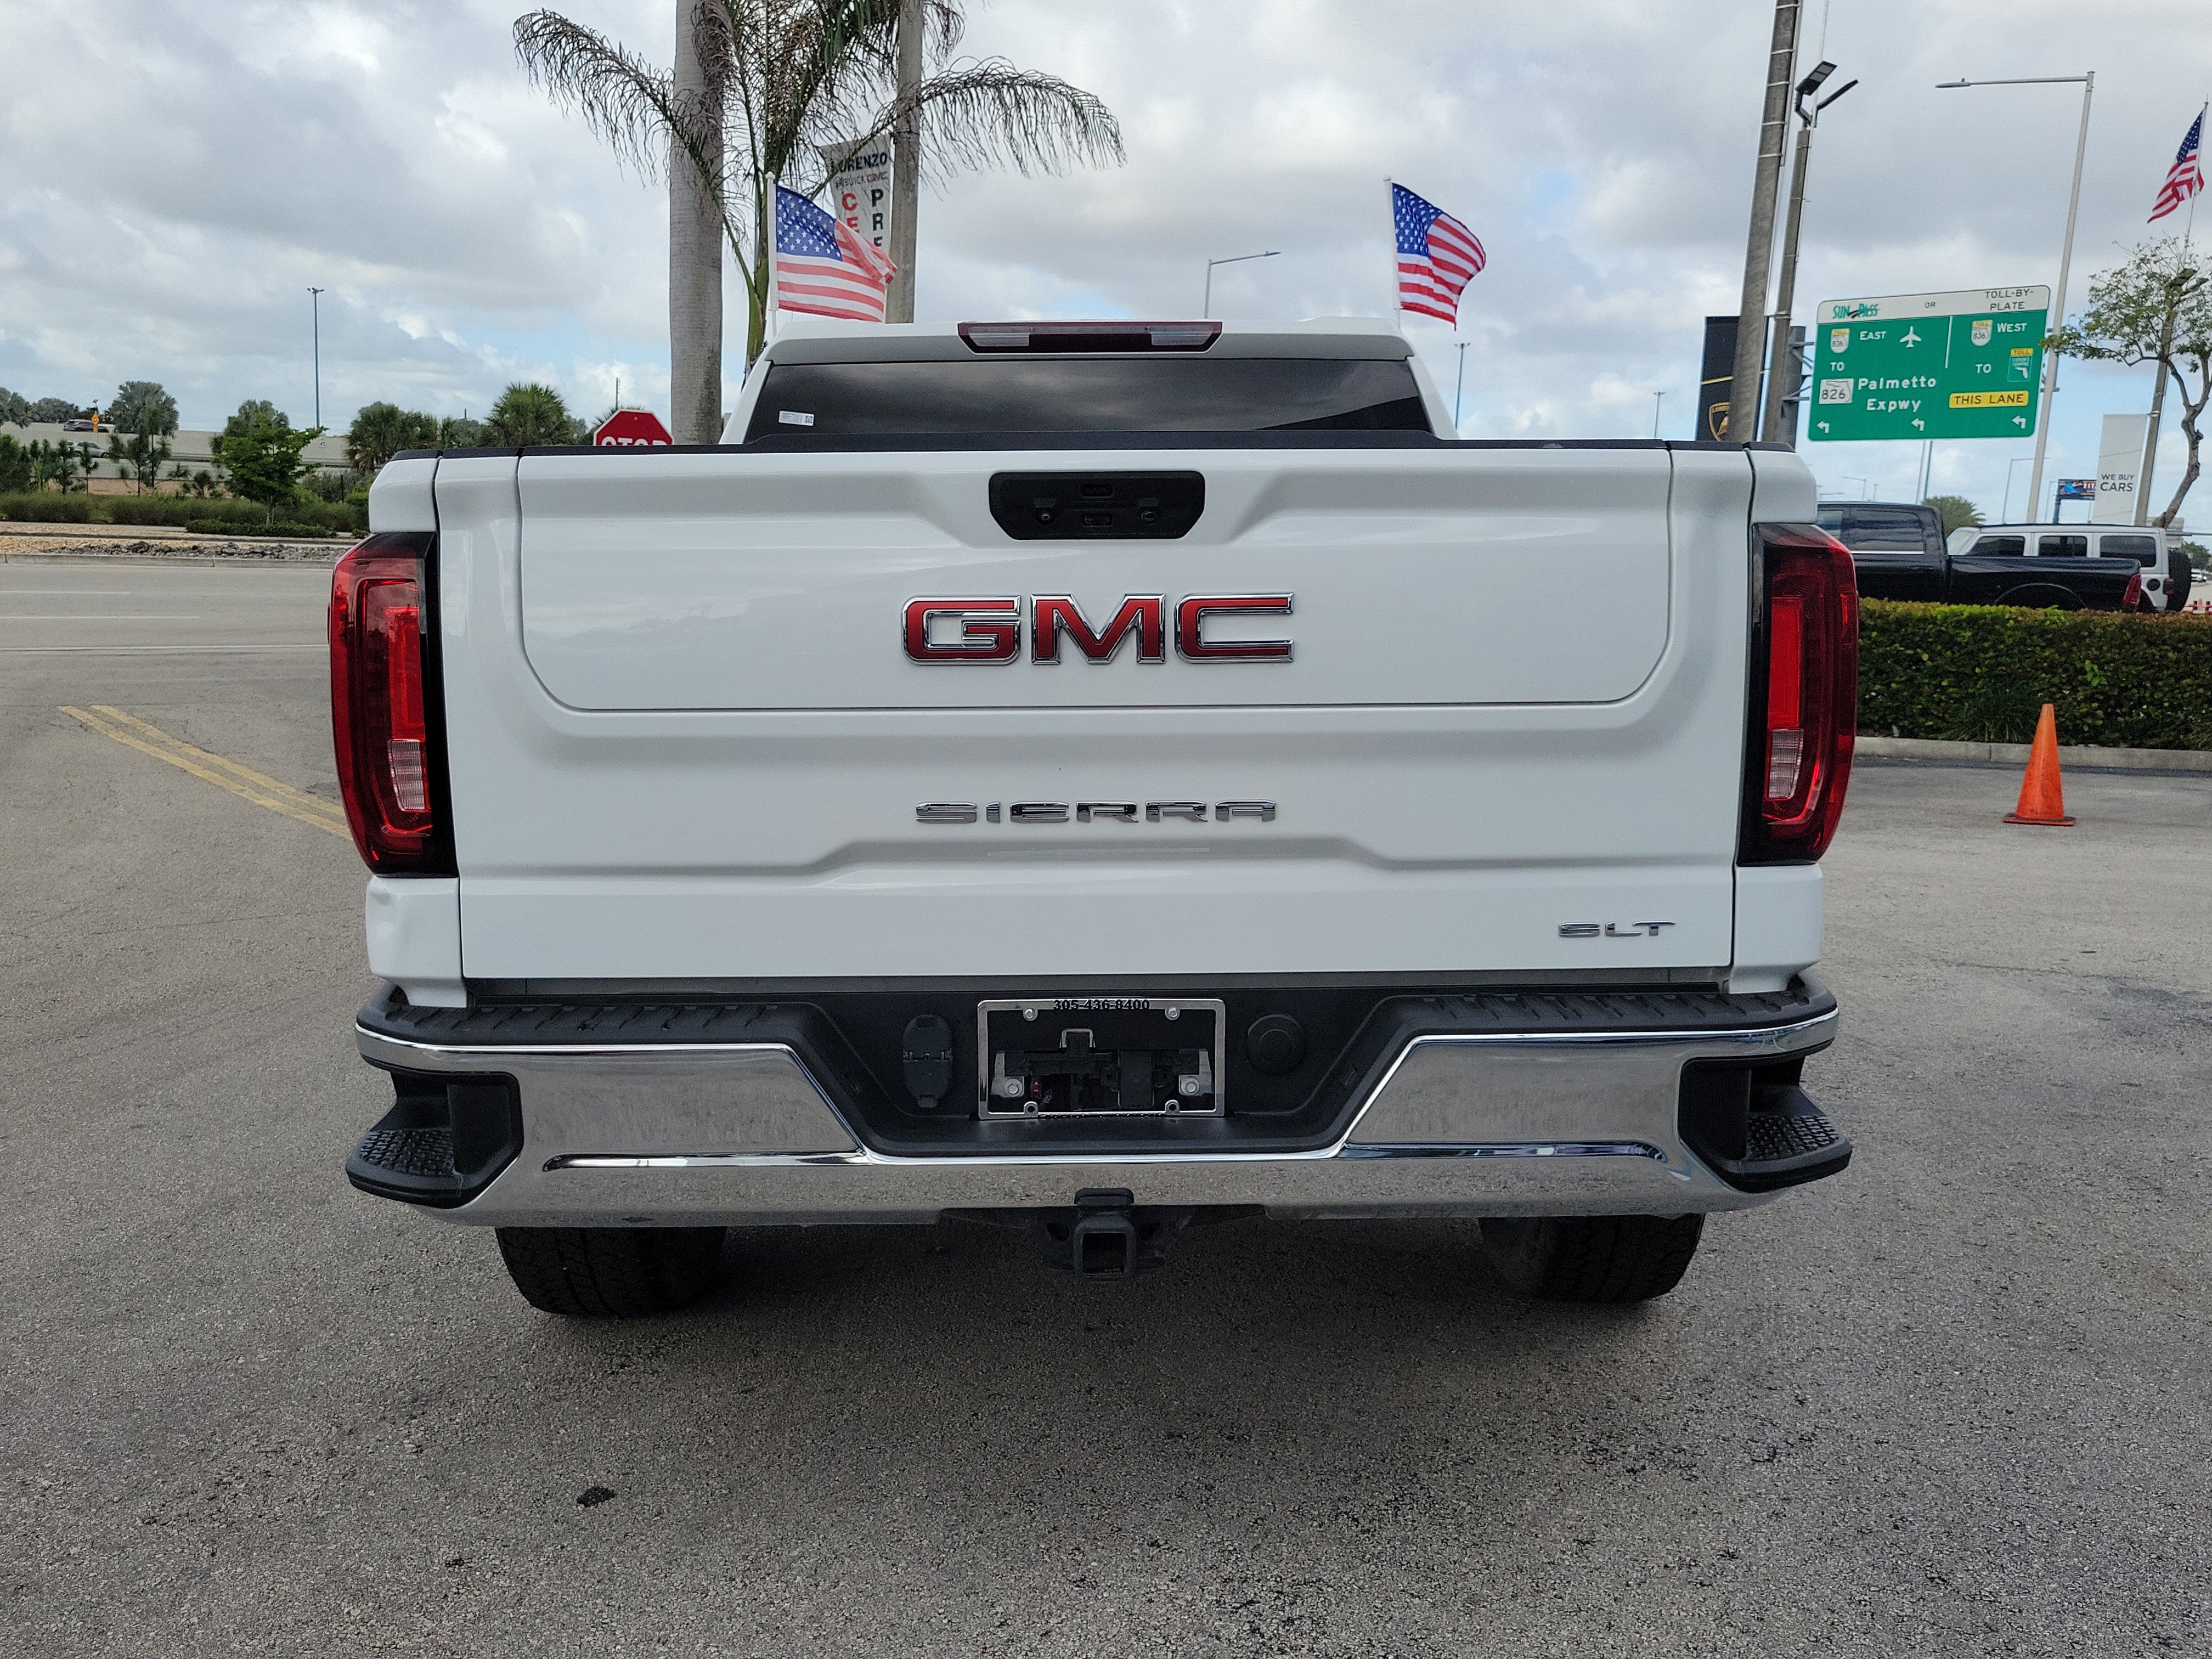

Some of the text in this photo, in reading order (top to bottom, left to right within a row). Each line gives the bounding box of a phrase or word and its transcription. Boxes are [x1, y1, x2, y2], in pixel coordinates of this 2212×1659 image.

[1990, 301, 2025, 311] PLATE
[1997, 322, 2027, 333] WEST
[1860, 330, 1887, 341] EAST
[1830, 361, 1844, 371] TO
[1975, 363, 1992, 374] TO
[1858, 375, 1937, 390] Palmetto
[1821, 389, 1846, 400] 826
[1954, 394, 2024, 405] THIS LANE
[1866, 398, 1921, 413] Expwy
[2100, 482, 2133, 492] CARS
[901, 591, 1294, 667] GMC
[915, 799, 1277, 825] SIERRA
[1558, 920, 1676, 938] SLT
[1053, 999, 1150, 1010] 305-436-8400
